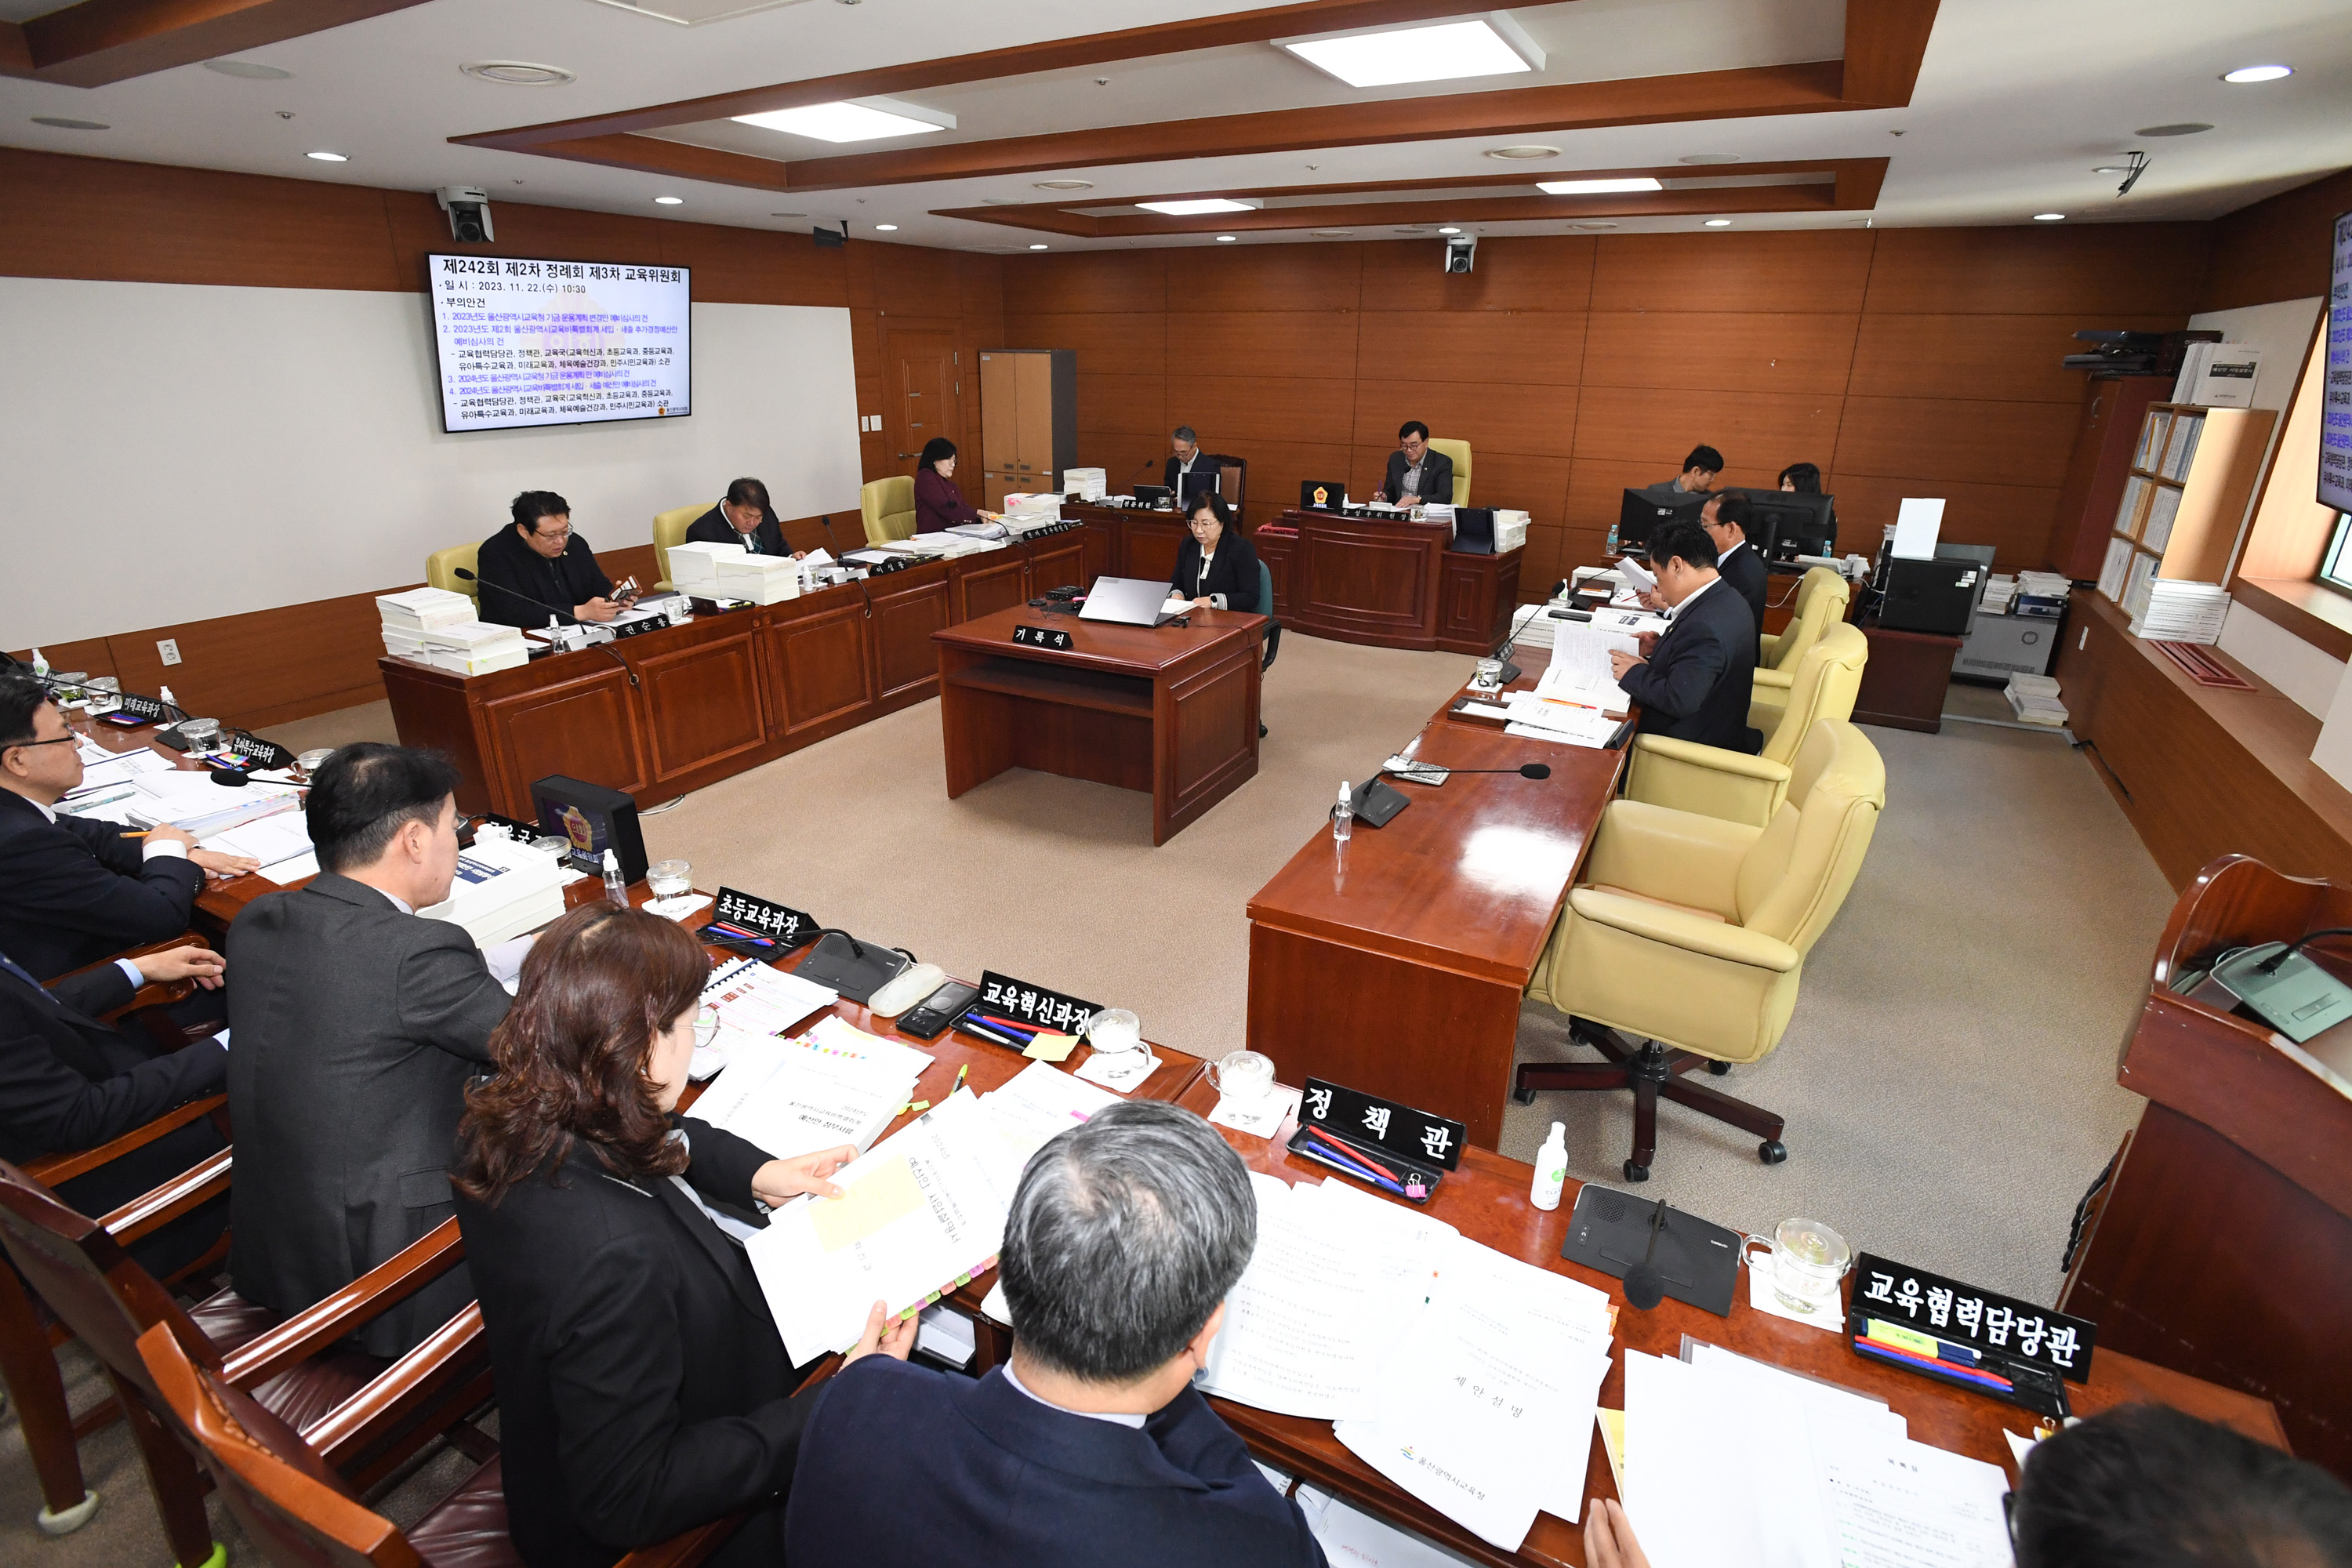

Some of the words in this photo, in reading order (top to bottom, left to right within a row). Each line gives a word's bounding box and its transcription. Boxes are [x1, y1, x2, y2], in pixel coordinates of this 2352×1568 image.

[443, 258, 499, 276] 제242회
[506, 261, 541, 278] 제2차
[546, 263, 584, 279] 정례회
[589, 266, 621, 281] 제3차
[625, 268, 681, 283] 교육위원회
[479, 281, 506, 291] 2023.
[510, 283, 524, 292] 11.
[562, 285, 586, 294] 10:30
[446, 297, 485, 308] 부의안건
[452, 312, 487, 321] 2023년도
[488, 312, 545, 321] 울산광역시교육청
[453, 325, 489, 333] 2023년도
[492, 325, 512, 334] 제2회
[454, 337, 495, 347] 예비심사의
[497, 337, 504, 347] 건
[658, 358, 670, 367] 소관
[458, 373, 490, 383] 2024년도
[459, 386, 490, 395] 2024년도
[124, 697, 160, 718] 미래교육과장
[234, 736, 274, 764] 유아특수교육과장
[717, 893, 800, 939] 초등교육과장
[982, 982, 1093, 1036] 교육혁신과장
[909, 1157, 931, 1189] 예산안
[1864, 1270, 2082, 1369] 교육협력담당관
